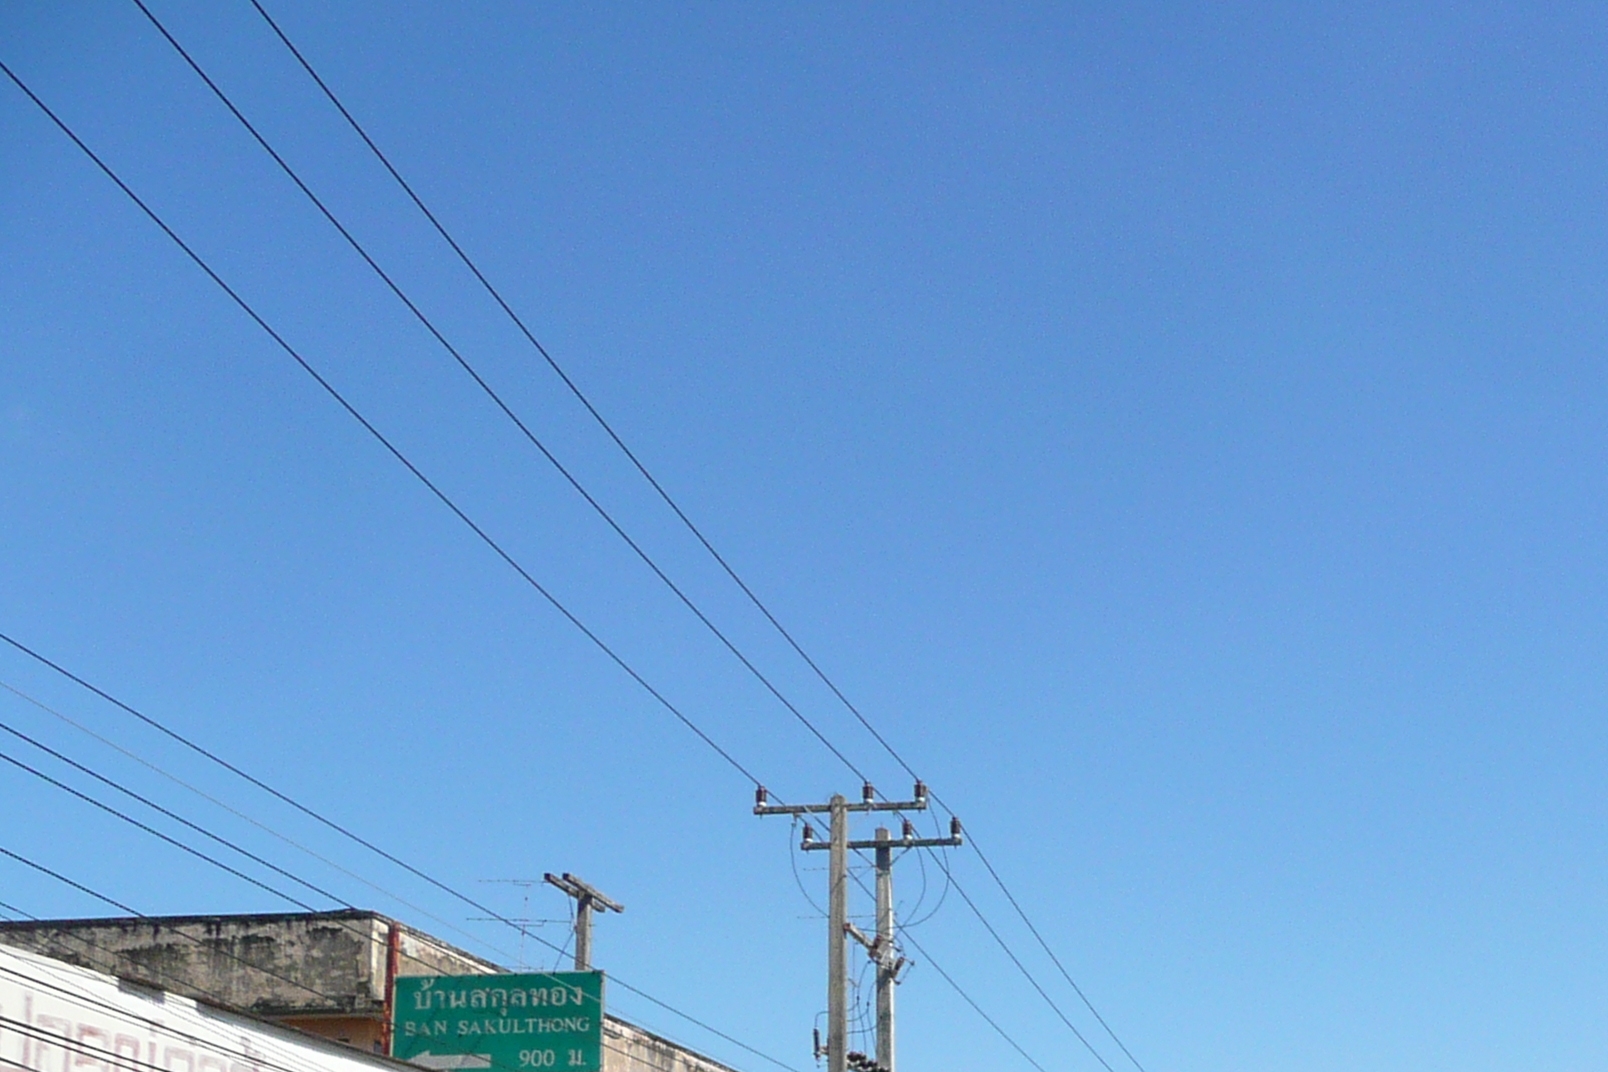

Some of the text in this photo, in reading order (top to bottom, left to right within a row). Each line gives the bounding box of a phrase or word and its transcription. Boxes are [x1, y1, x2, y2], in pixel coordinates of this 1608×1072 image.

[413, 979, 583, 1016] บ้านสกุลทอง
[457, 1017, 590, 1034] SAKULTHONG
[519, 1050, 555, 1067] 900
